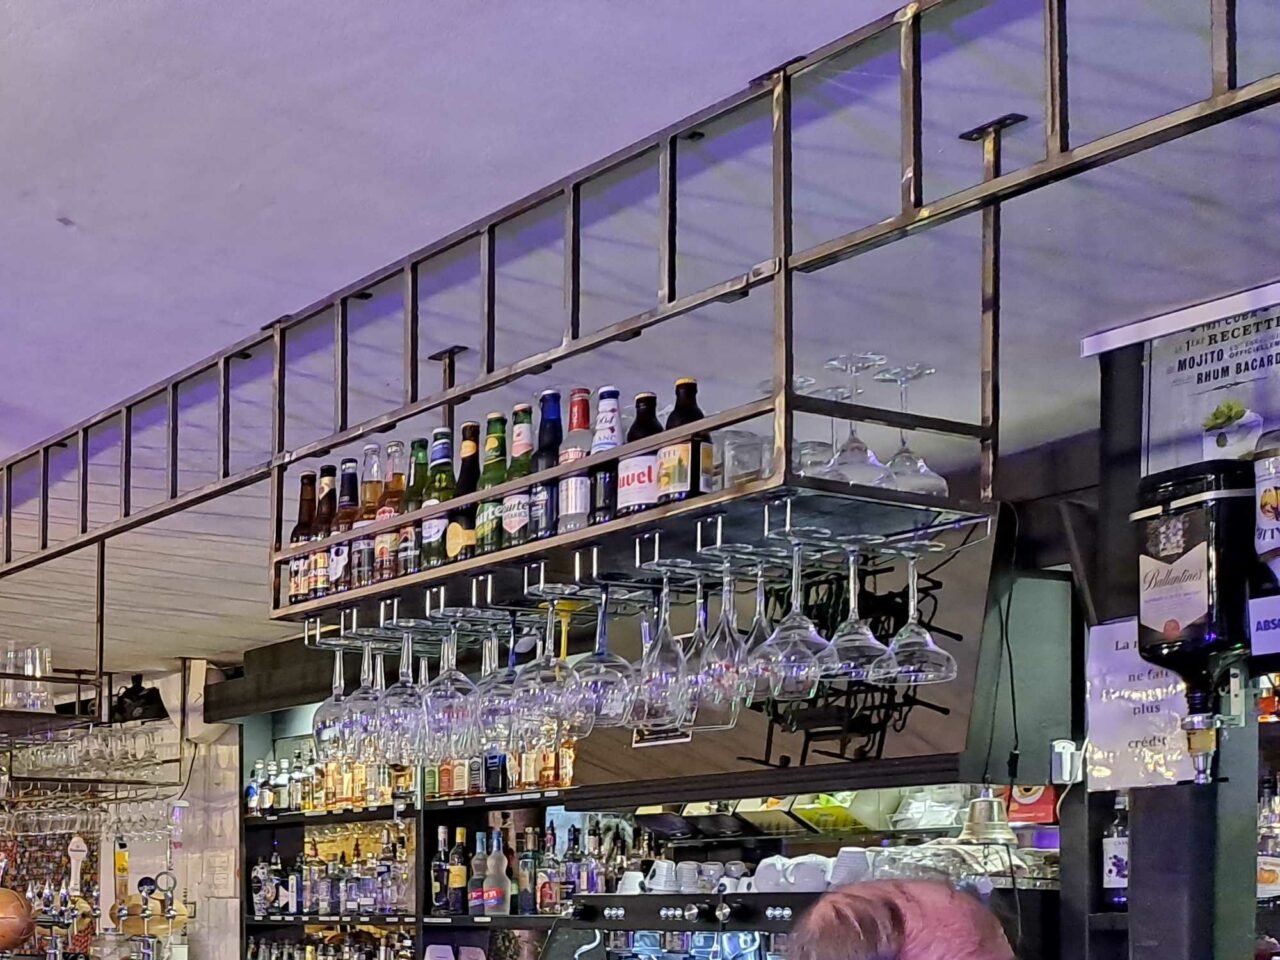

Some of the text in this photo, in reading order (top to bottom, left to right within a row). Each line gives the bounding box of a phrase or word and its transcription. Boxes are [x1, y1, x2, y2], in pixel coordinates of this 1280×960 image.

[1177, 348, 1224, 372] MOJITO
[1196, 365, 1230, 384] RHUM
[1115, 640, 1129, 650] La
[1128, 672, 1144, 682] ne
[1133, 702, 1161, 716] plus
